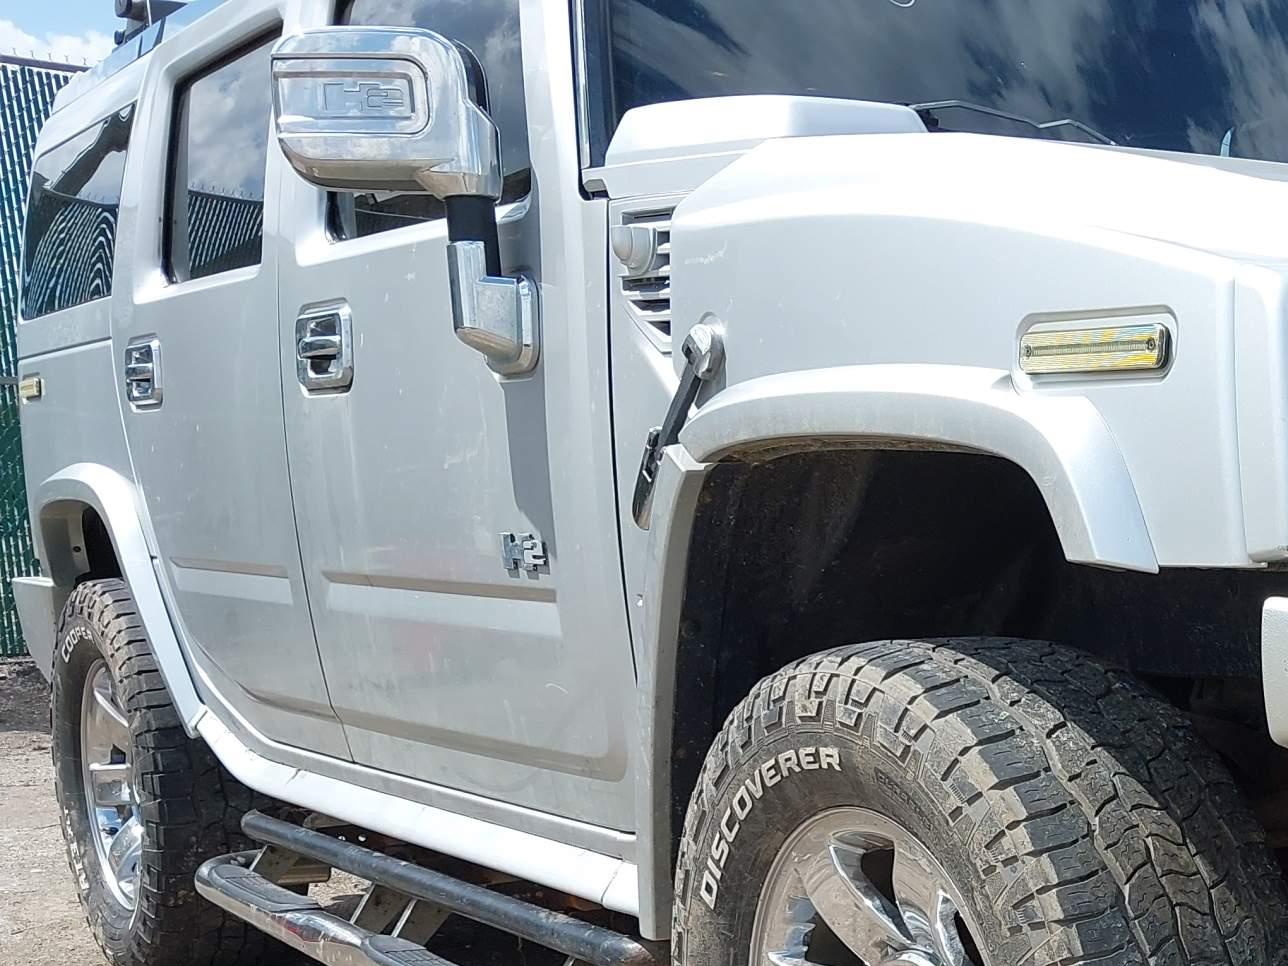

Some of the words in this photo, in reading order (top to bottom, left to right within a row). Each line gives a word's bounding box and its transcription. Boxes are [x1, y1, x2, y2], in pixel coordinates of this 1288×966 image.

[501, 532, 547, 572] H2
[61, 625, 94, 663] COOPER
[700, 747, 842, 910] DISCOVERER
